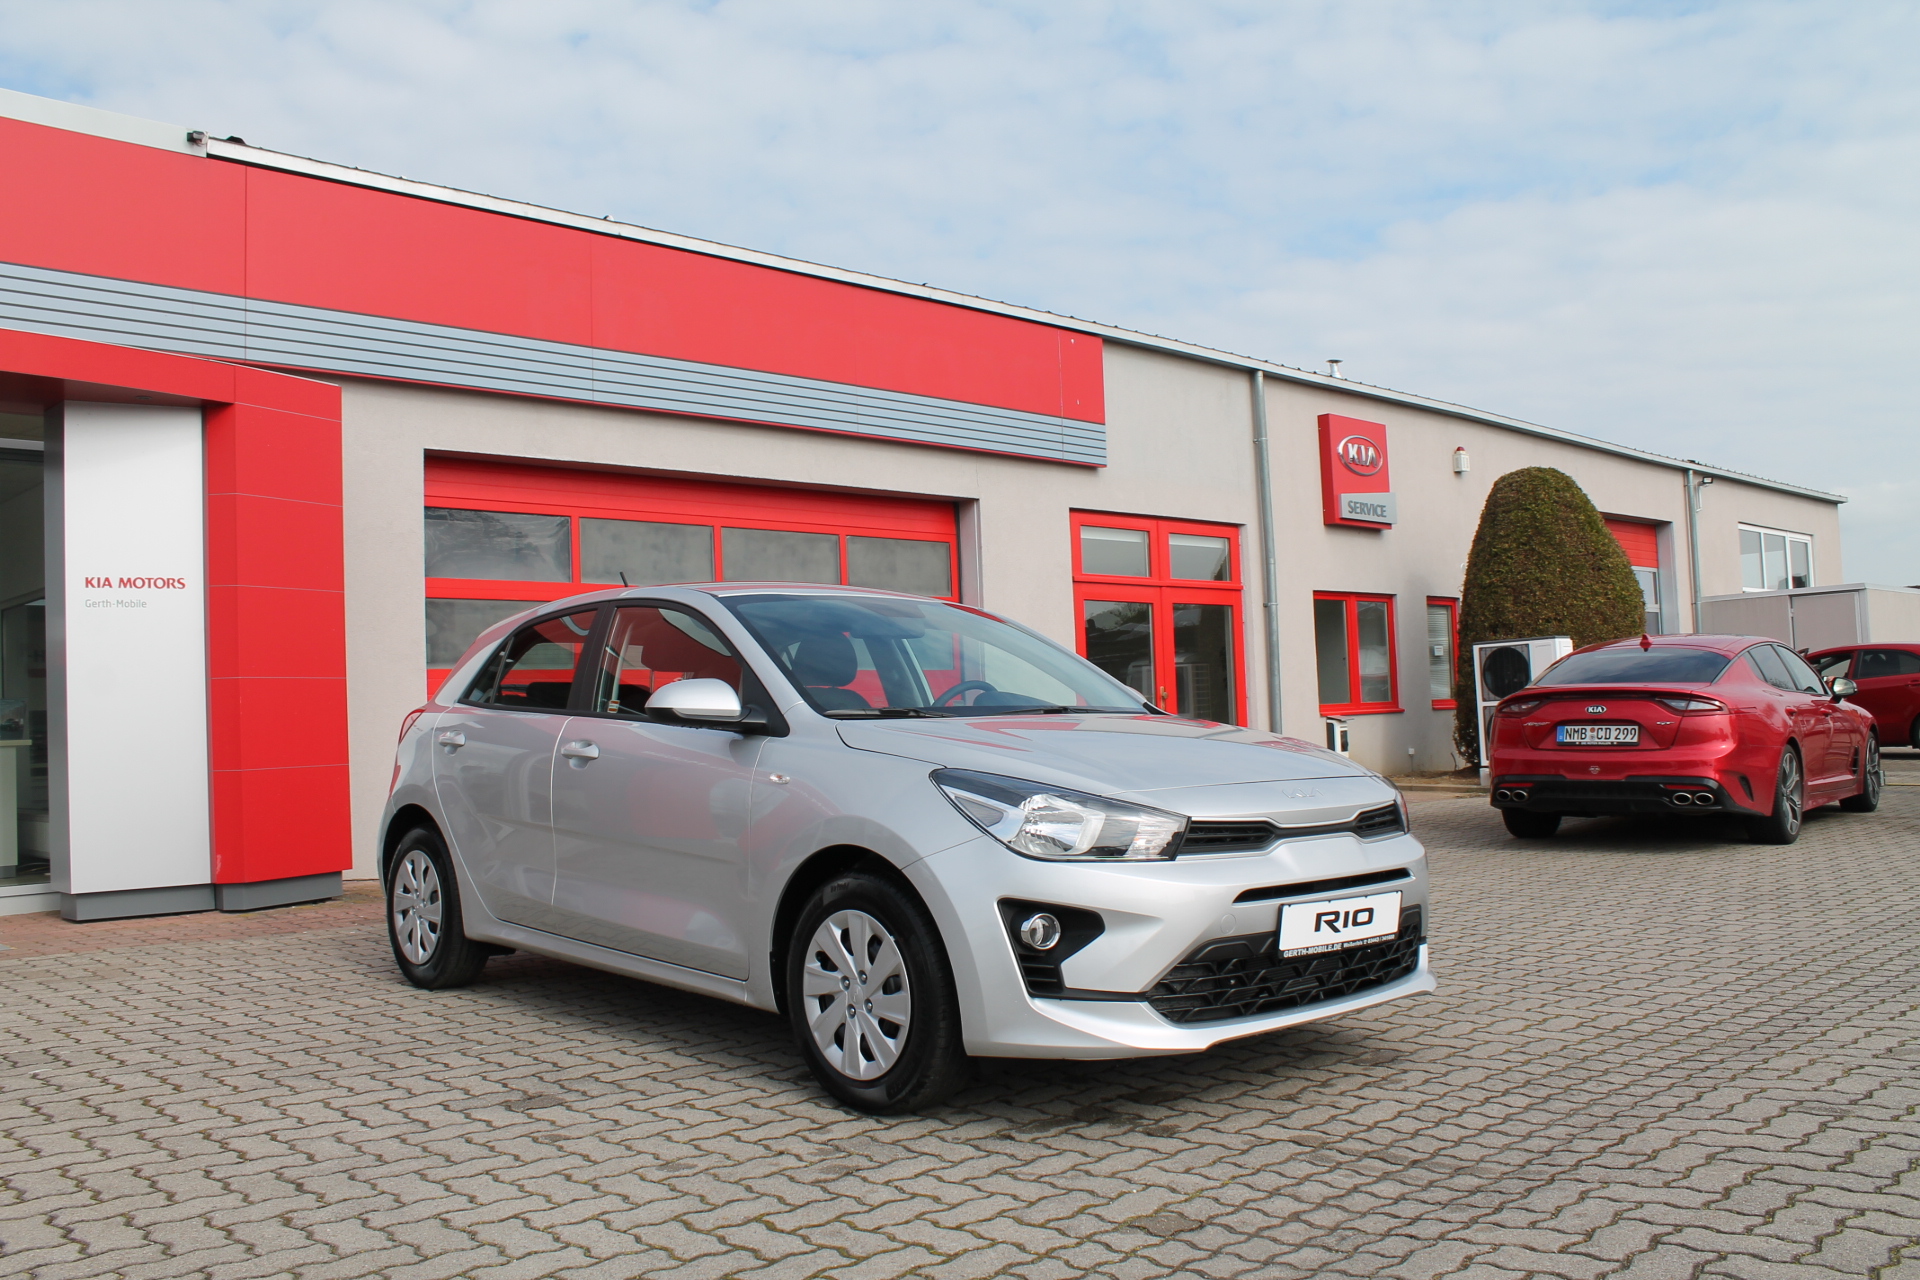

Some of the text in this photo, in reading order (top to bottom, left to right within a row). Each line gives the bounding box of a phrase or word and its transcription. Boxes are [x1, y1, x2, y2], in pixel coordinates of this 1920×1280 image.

[1346, 442, 1378, 468] KIA
[1347, 499, 1387, 518] SERVICE
[85, 576, 186, 590] KIA MOTORS
[85, 599, 147, 608] Gerth-Mobile
[1565, 727, 1637, 740] NMB CD 299
[1314, 908, 1374, 933] RIO
[1283, 943, 1342, 958] GERTH-MOBILE.DE
